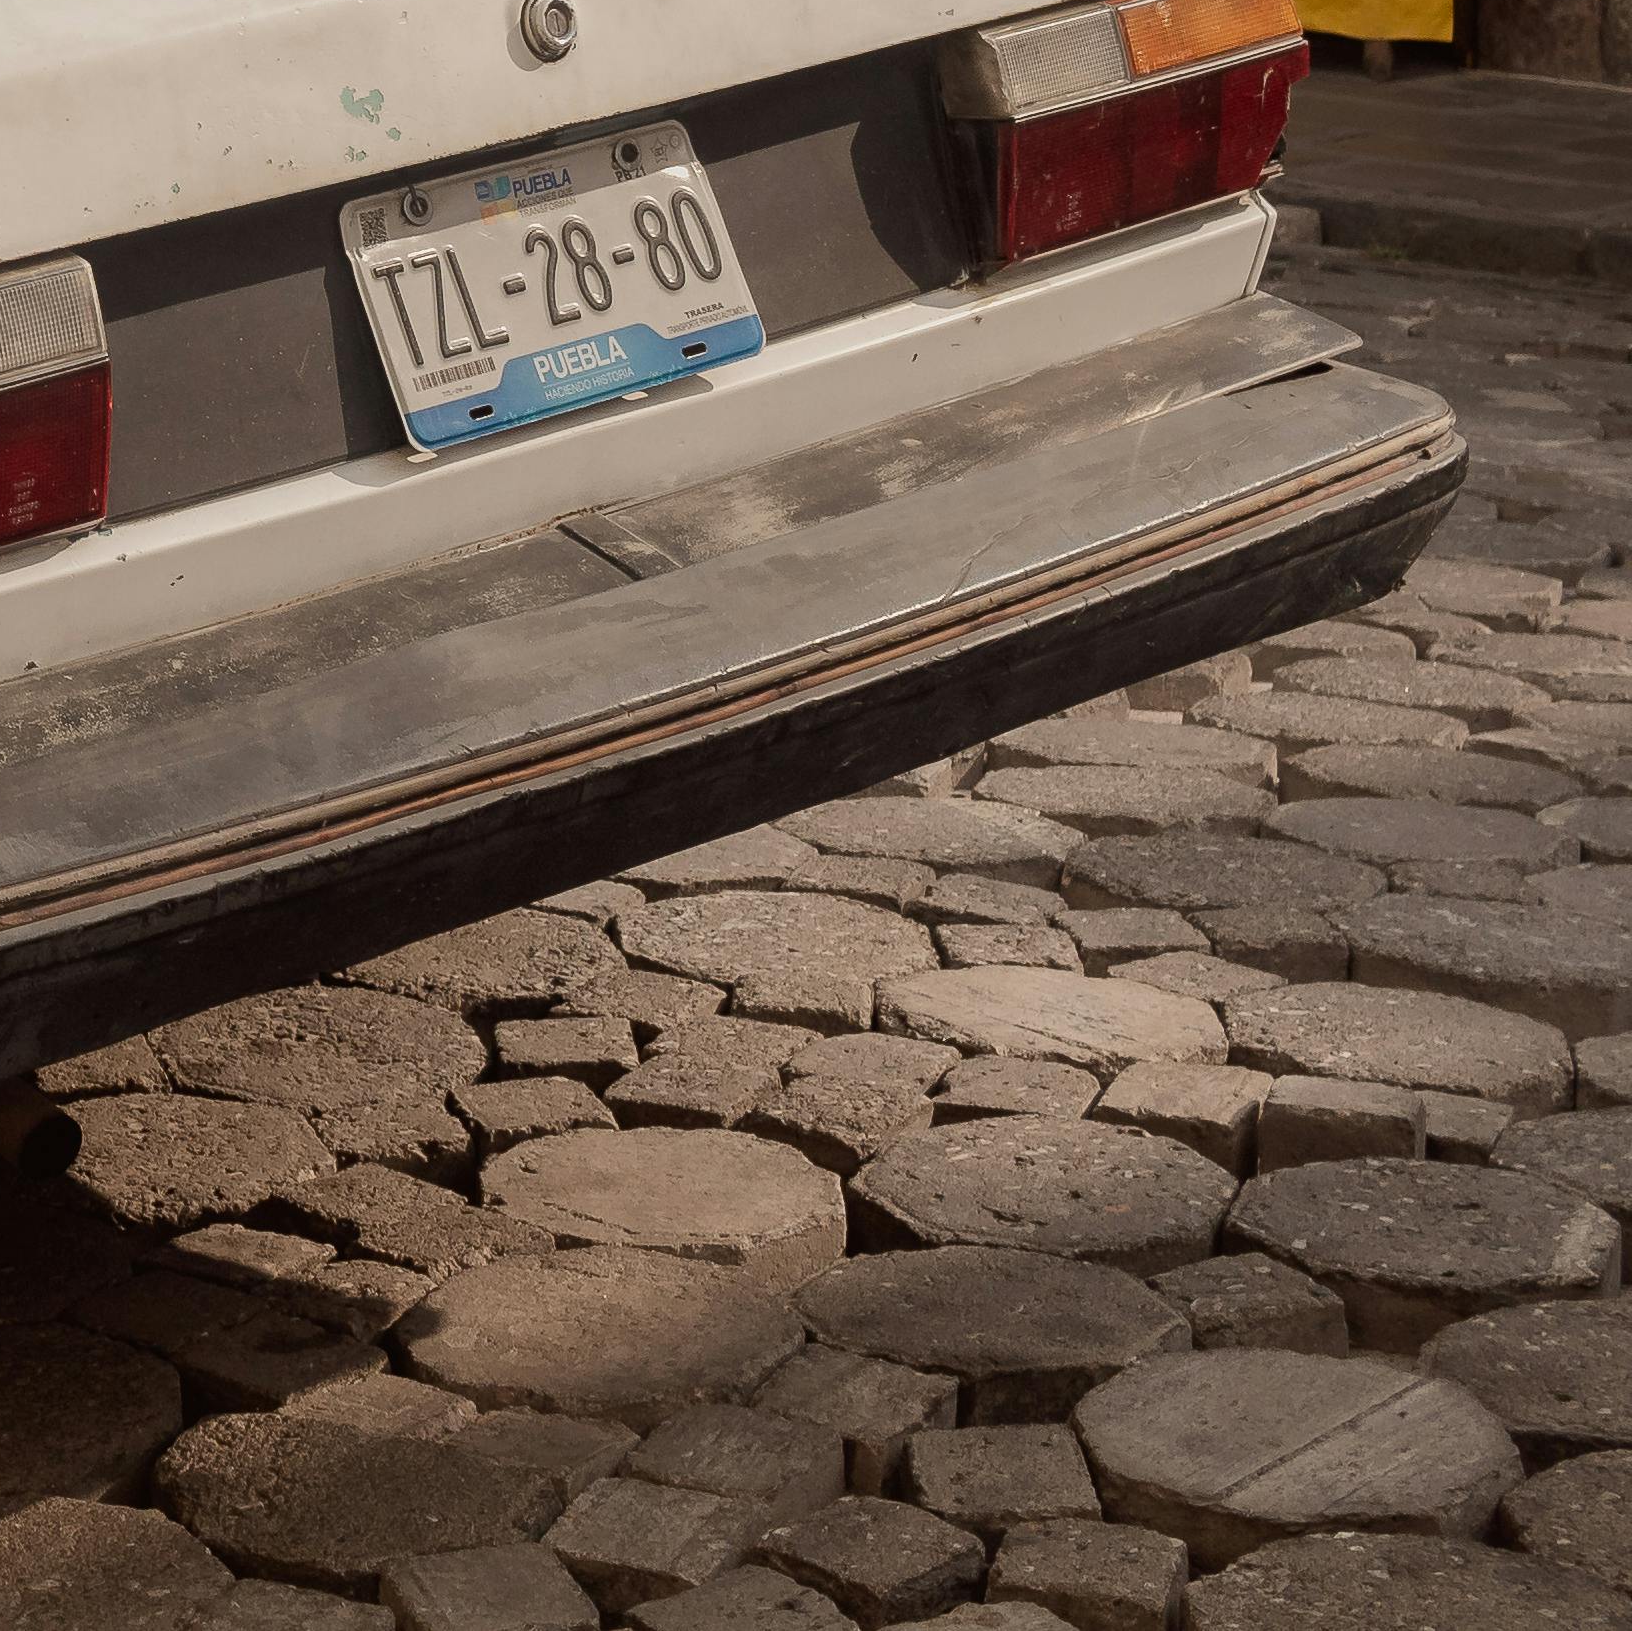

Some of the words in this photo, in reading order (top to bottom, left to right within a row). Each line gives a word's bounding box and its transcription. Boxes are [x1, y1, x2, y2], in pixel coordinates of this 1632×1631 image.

[512, 168, 573, 199] PUEBLA
[516, 190, 558, 210] ACCIONES
[557, 186, 575, 199] QUE
[371, 186, 722, 367] TZL-28-80
[684, 302, 724, 320] TRASERA
[535, 334, 628, 385] PUEBLA
[544, 375, 591, 402] HACIENDO
[590, 365, 635, 391] HISTORIA
